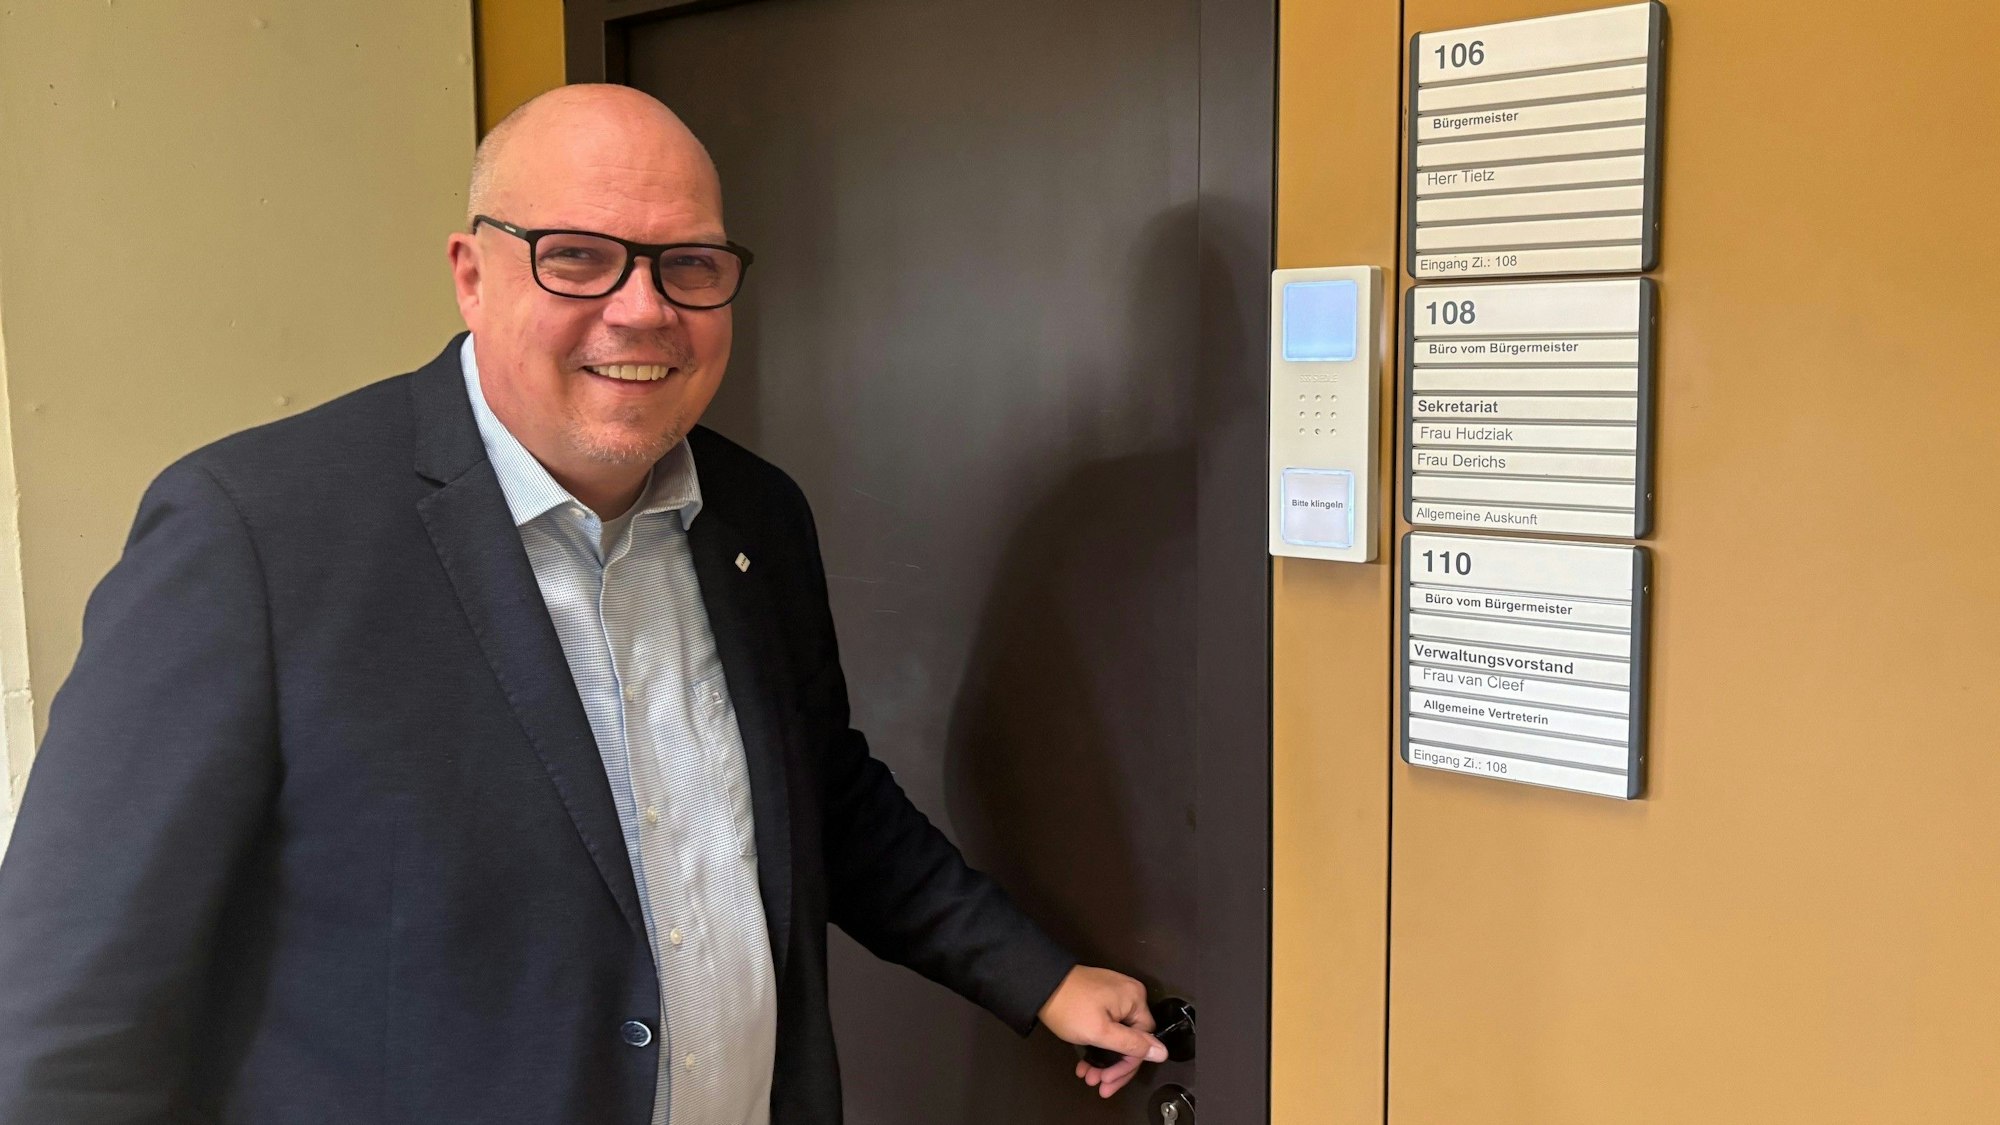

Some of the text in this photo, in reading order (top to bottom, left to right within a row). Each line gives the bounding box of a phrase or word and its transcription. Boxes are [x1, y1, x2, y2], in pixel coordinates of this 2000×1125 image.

[1434, 40, 1485, 70] 106
[1433, 112, 1519, 129] Bürgermeister
[1427, 170, 1495, 185] Herr Tietz
[1420, 256, 1517, 271] Eingang Zi.: 108
[1426, 300, 1476, 325] 108
[1429, 342, 1578, 355] Büro vom Bürgermeister
[1418, 400, 1498, 413] Sekretariat
[1420, 427, 1513, 441] Frau Hudziak
[1417, 453, 1506, 468] Frau Derichs
[1291, 499, 1343, 510] Bitte klingeln
[1416, 508, 1538, 525] Allgemeine Auskunft
[1423, 550, 1472, 576] 110
[1425, 593, 1572, 615] Büro vom Bürgermeister
[1414, 644, 1574, 675] Verwaltungsvorstand
[1423, 668, 1524, 692] Frau van Cleef
[1424, 700, 1548, 725] Allgemeine Vertreterin
[1414, 749, 1507, 773] Eingang Zi.: 108
